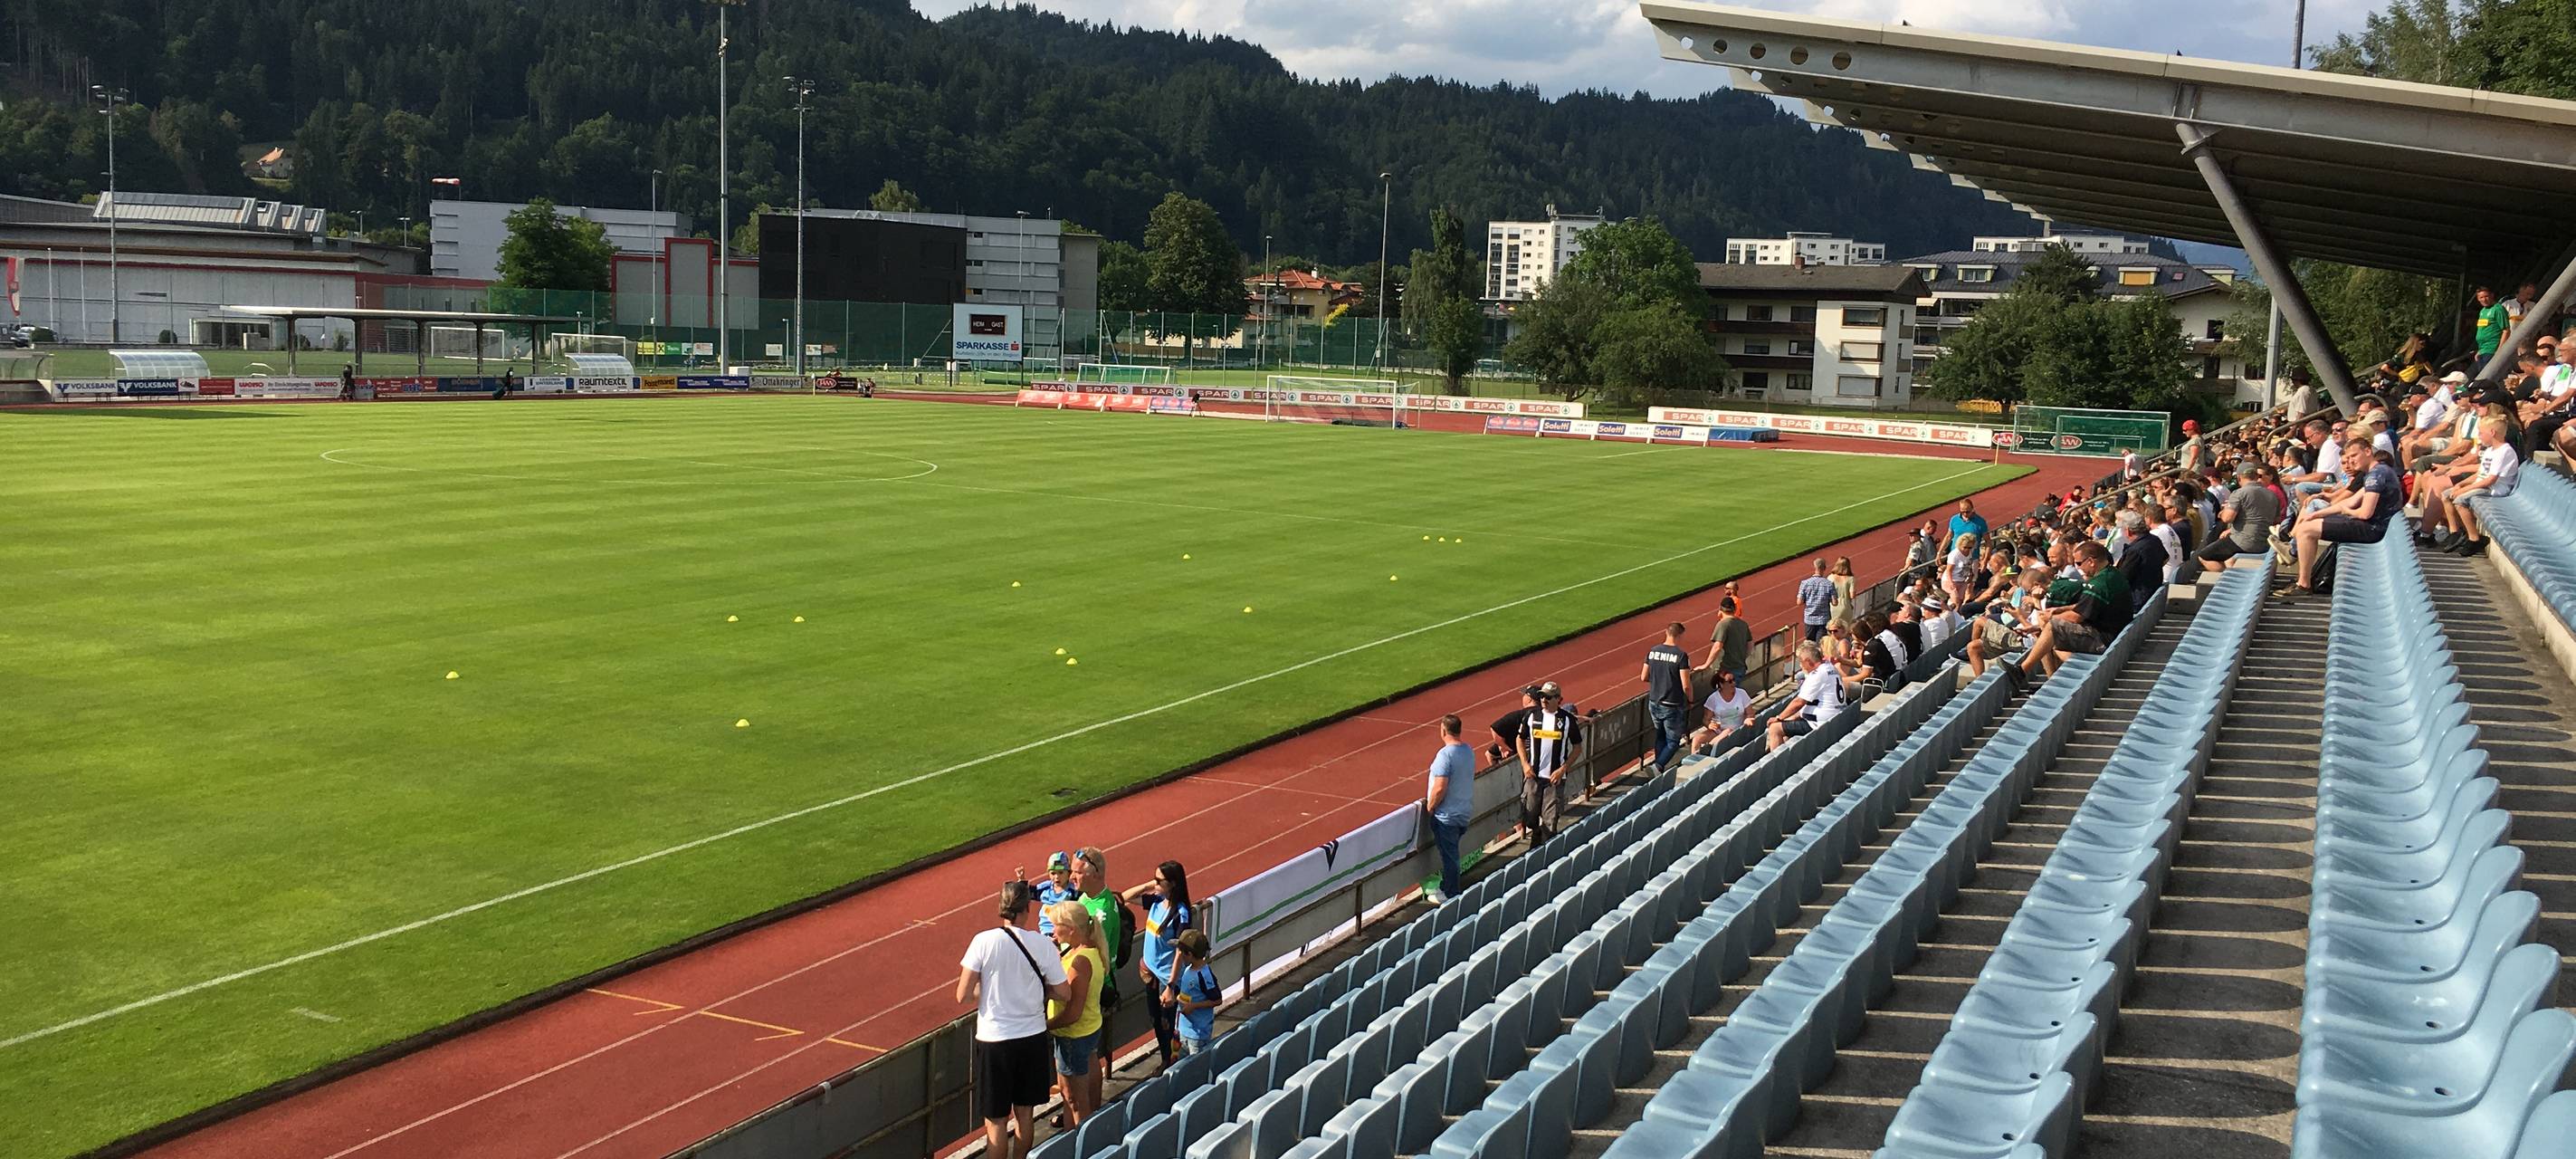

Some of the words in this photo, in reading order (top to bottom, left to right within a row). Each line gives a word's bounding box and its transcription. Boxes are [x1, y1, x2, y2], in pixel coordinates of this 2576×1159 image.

[956, 341, 1009, 350] SPARKASSE
[1197, 390, 1229, 398] SPAR
[1474, 401, 1505, 410] SPAR
[1528, 404, 1560, 413] SPAR
[1672, 413, 1703, 421] SPAR
[1726, 416, 1758, 424] SPAR
[1544, 421, 1569, 431] Soletti
[1779, 419, 1811, 427] SPAR
[1833, 423, 1865, 432] SPAR
[1598, 425, 1625, 434] Soletti
[1655, 427, 1682, 436] Soletti
[1886, 426, 1918, 436] SPAR
[1939, 430, 1969, 439] SPAR
[1648, 651, 1677, 663] DENIM
[1836, 676, 1845, 704] 6
